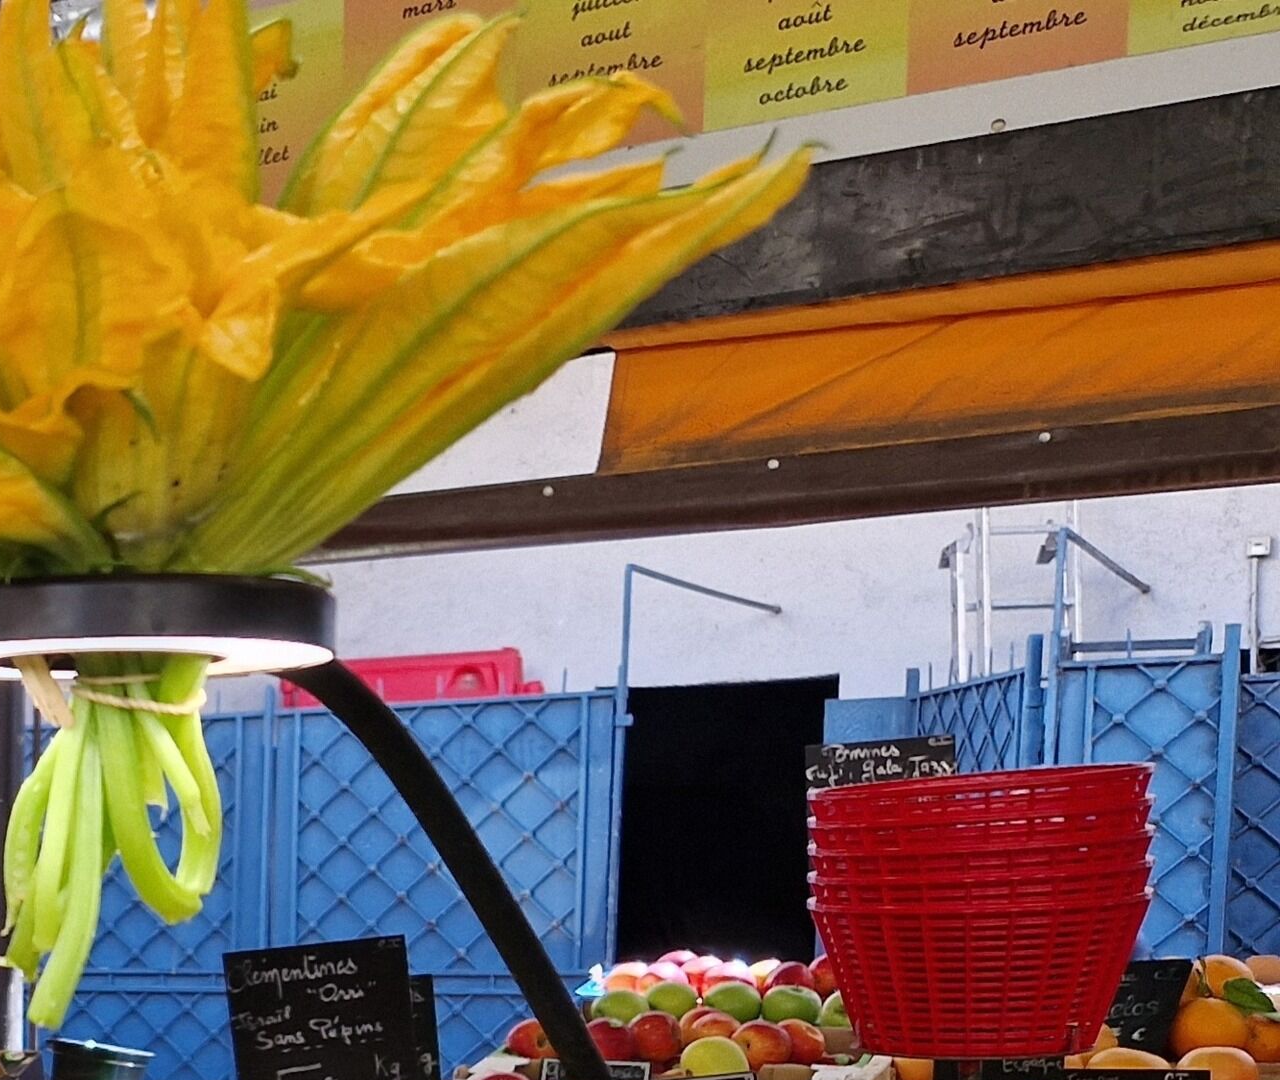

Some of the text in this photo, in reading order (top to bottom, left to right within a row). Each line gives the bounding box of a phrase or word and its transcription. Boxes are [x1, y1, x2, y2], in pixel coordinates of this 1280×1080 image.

[777, 0, 834, 32] août
[952, 9, 1089, 50] septembre
[1182, 3, 1280, 33] décembr
[581, 21, 632, 47] aout
[743, 35, 868, 75] septembre
[759, 74, 850, 107] octobre
